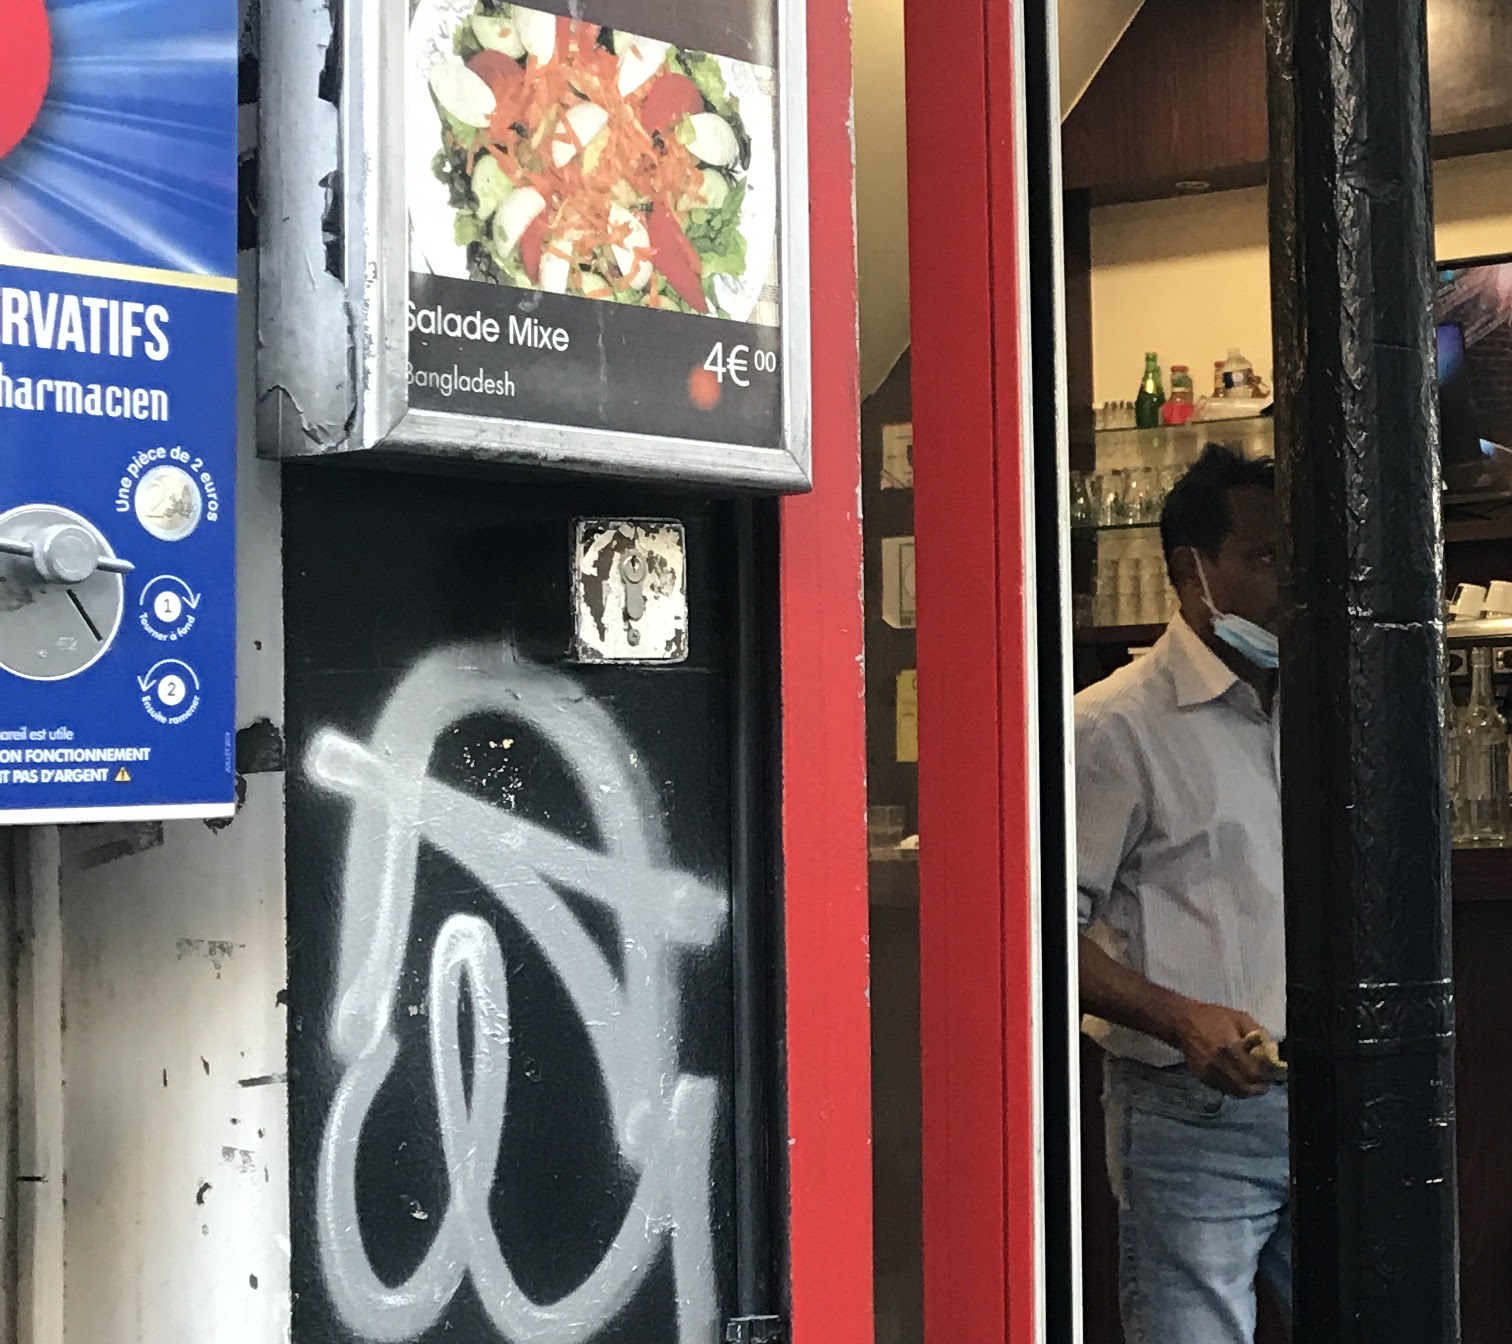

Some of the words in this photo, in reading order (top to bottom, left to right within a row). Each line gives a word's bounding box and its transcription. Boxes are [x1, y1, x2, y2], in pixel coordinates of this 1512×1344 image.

[1, 287, 170, 361] RVATIFS
[407, 300, 500, 342] Salade
[508, 315, 570, 352] Mixe
[406, 361, 515, 397] Bangladesh
[115, 476, 132, 513] Une
[127, 447, 167, 478] pièce
[170, 446, 190, 463] de
[190, 458, 204, 472] 2
[200, 472, 219, 522] euros
[163, 598, 172, 614] 1
[139, 612, 168, 641] Tourner
[176, 614, 196, 638] fond
[166, 682, 176, 696] 2
[29, 729, 46, 740] est
[49, 726, 74, 740] utile
[25, 747, 151, 763] FONCTIONNEMENT
[13, 770, 38, 783] PAS
[41, 768, 109, 782] D'ARGENT
